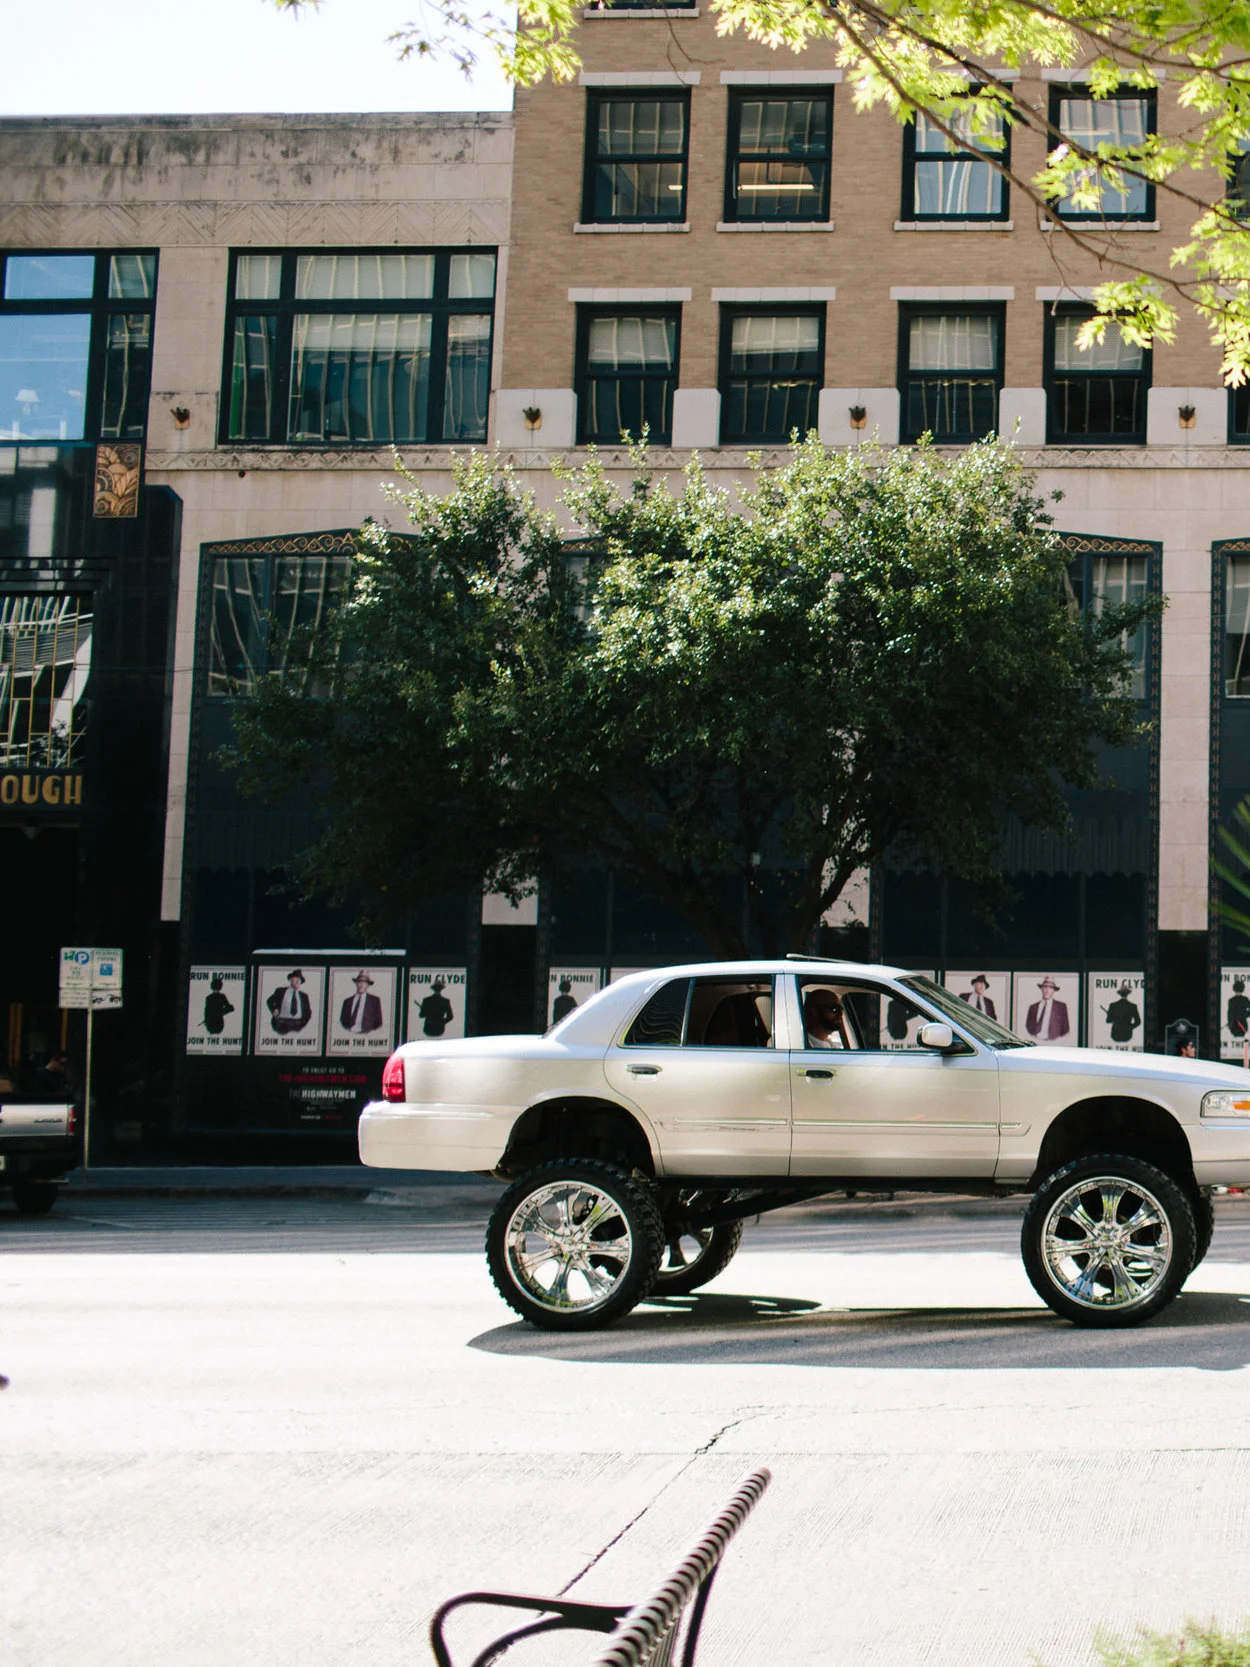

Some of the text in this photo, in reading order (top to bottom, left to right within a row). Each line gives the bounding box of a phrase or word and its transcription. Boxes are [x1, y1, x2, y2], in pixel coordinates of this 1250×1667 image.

[0, 774, 83, 805] OUGH
[190, 972, 245, 981] RUN BONNIE
[410, 974, 465, 984] RUN CLYDE
[560, 974, 593, 983] BONNIE
[1096, 979, 1118, 988] RUN
[187, 1037, 242, 1045] JOIN THE HUNT
[262, 1038, 316, 1046] JOIN THE HUNT
[333, 1039, 388, 1047] JOIN THE HUNT
[301, 1089, 356, 1099] HIGHWAYMEN
